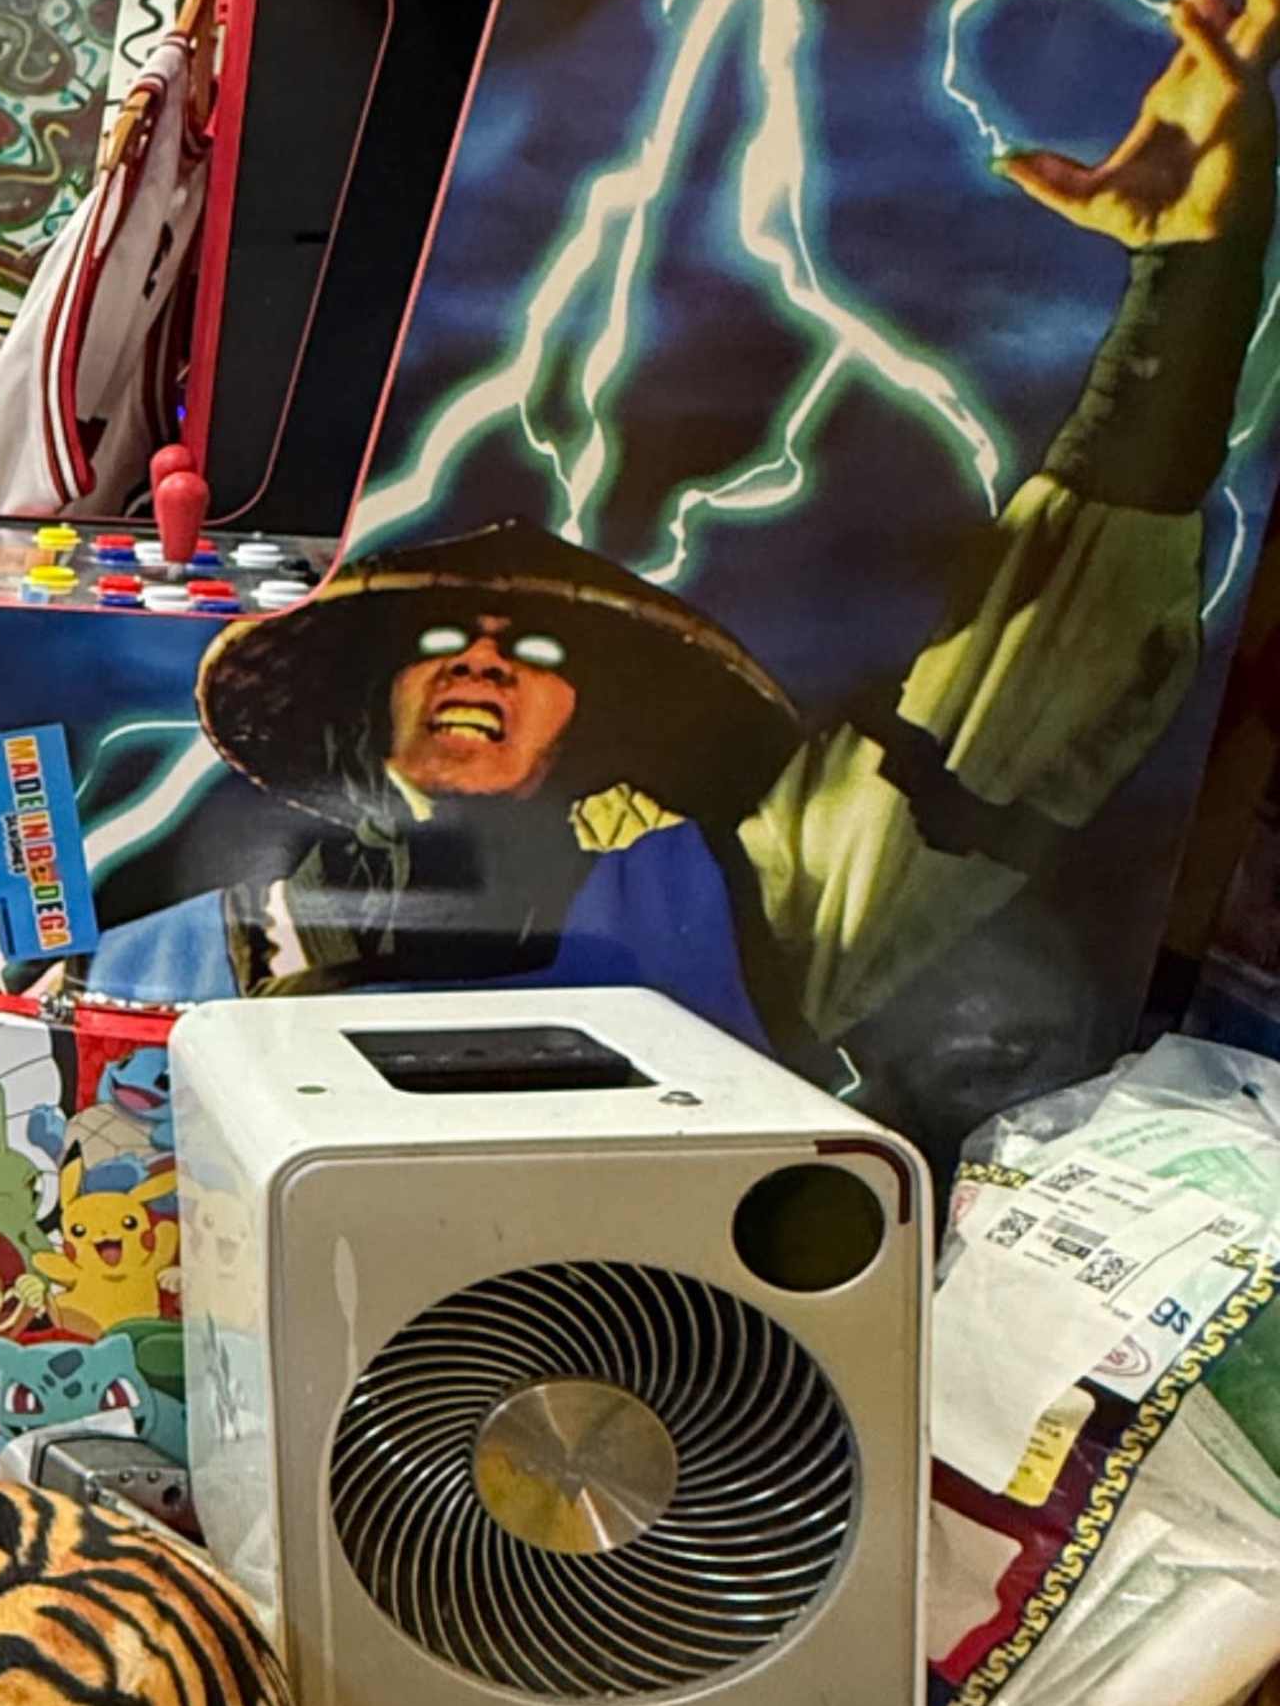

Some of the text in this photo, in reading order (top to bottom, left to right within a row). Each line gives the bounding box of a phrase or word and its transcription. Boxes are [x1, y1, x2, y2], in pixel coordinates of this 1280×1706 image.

[3, 734, 73, 950] MADE IN BODEGA
